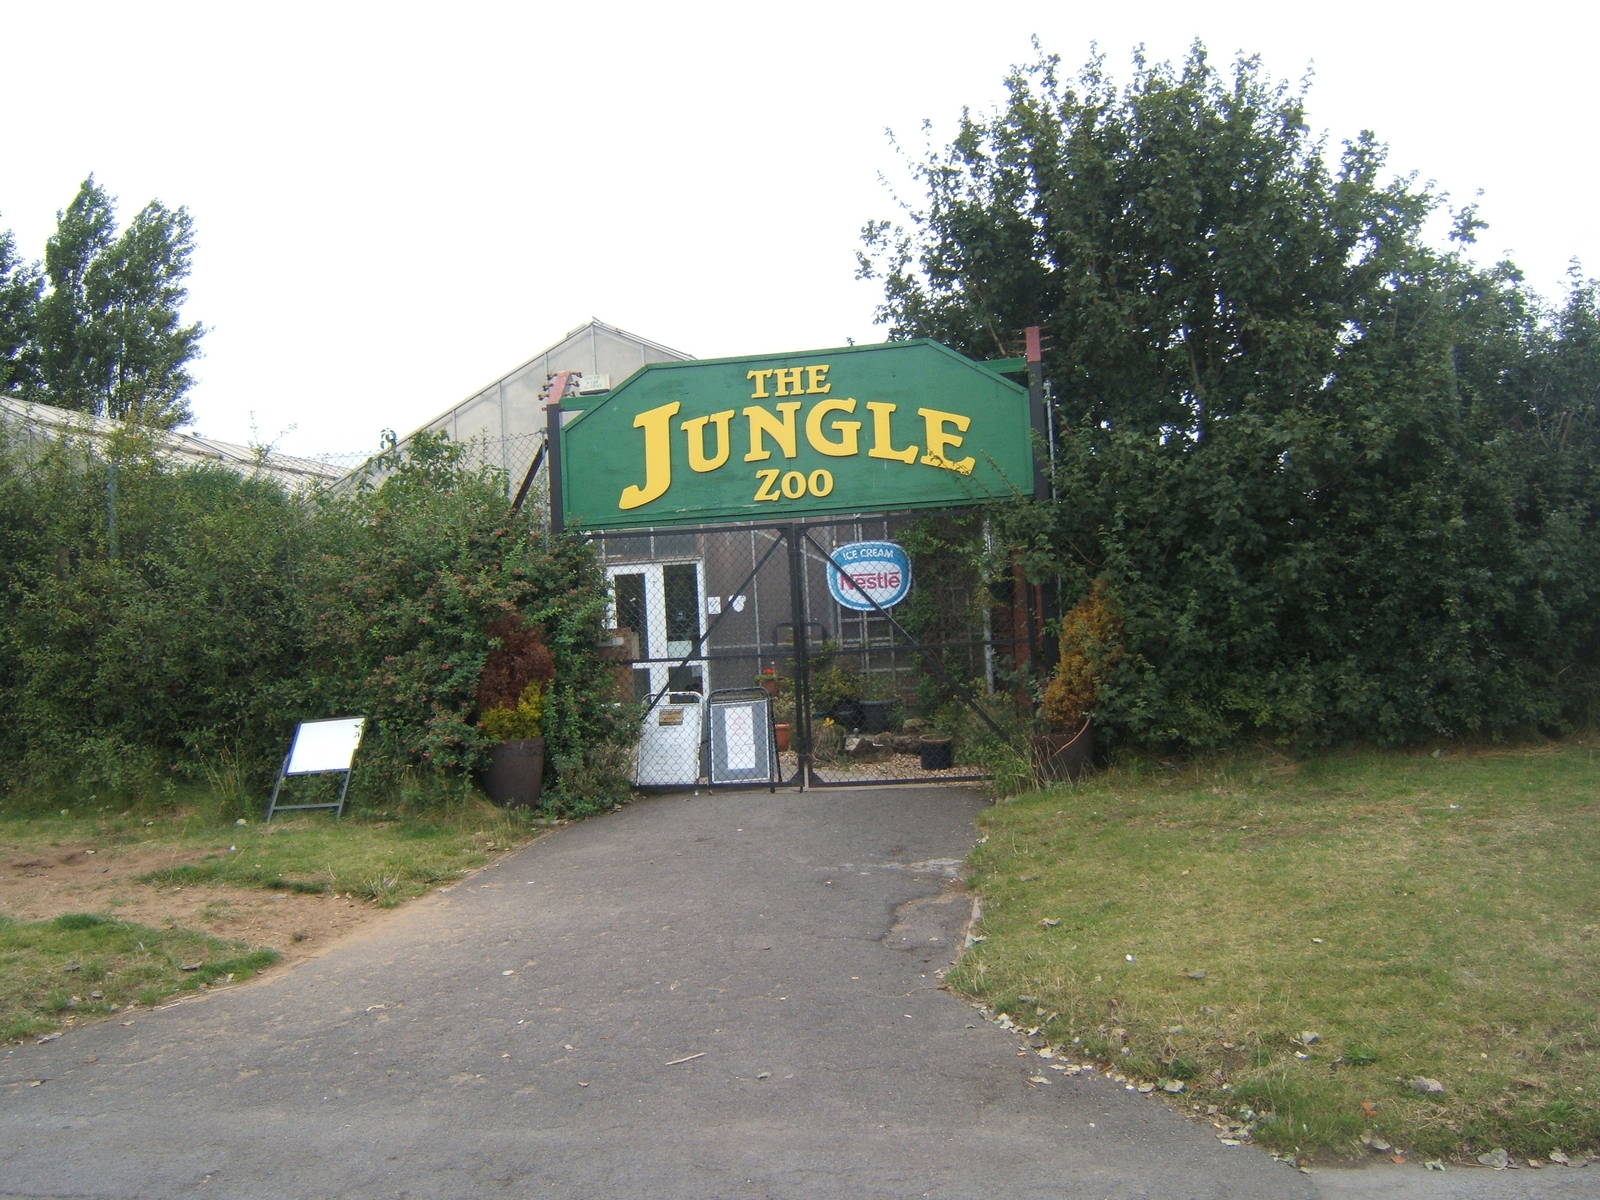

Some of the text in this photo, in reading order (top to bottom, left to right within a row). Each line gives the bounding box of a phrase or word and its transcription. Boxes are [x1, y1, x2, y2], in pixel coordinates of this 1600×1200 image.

[748, 365, 831, 398] THE
[619, 399, 977, 511] JUNGLE
[754, 468, 835, 502] ZOO
[842, 548, 894, 561] ICE CREAM
